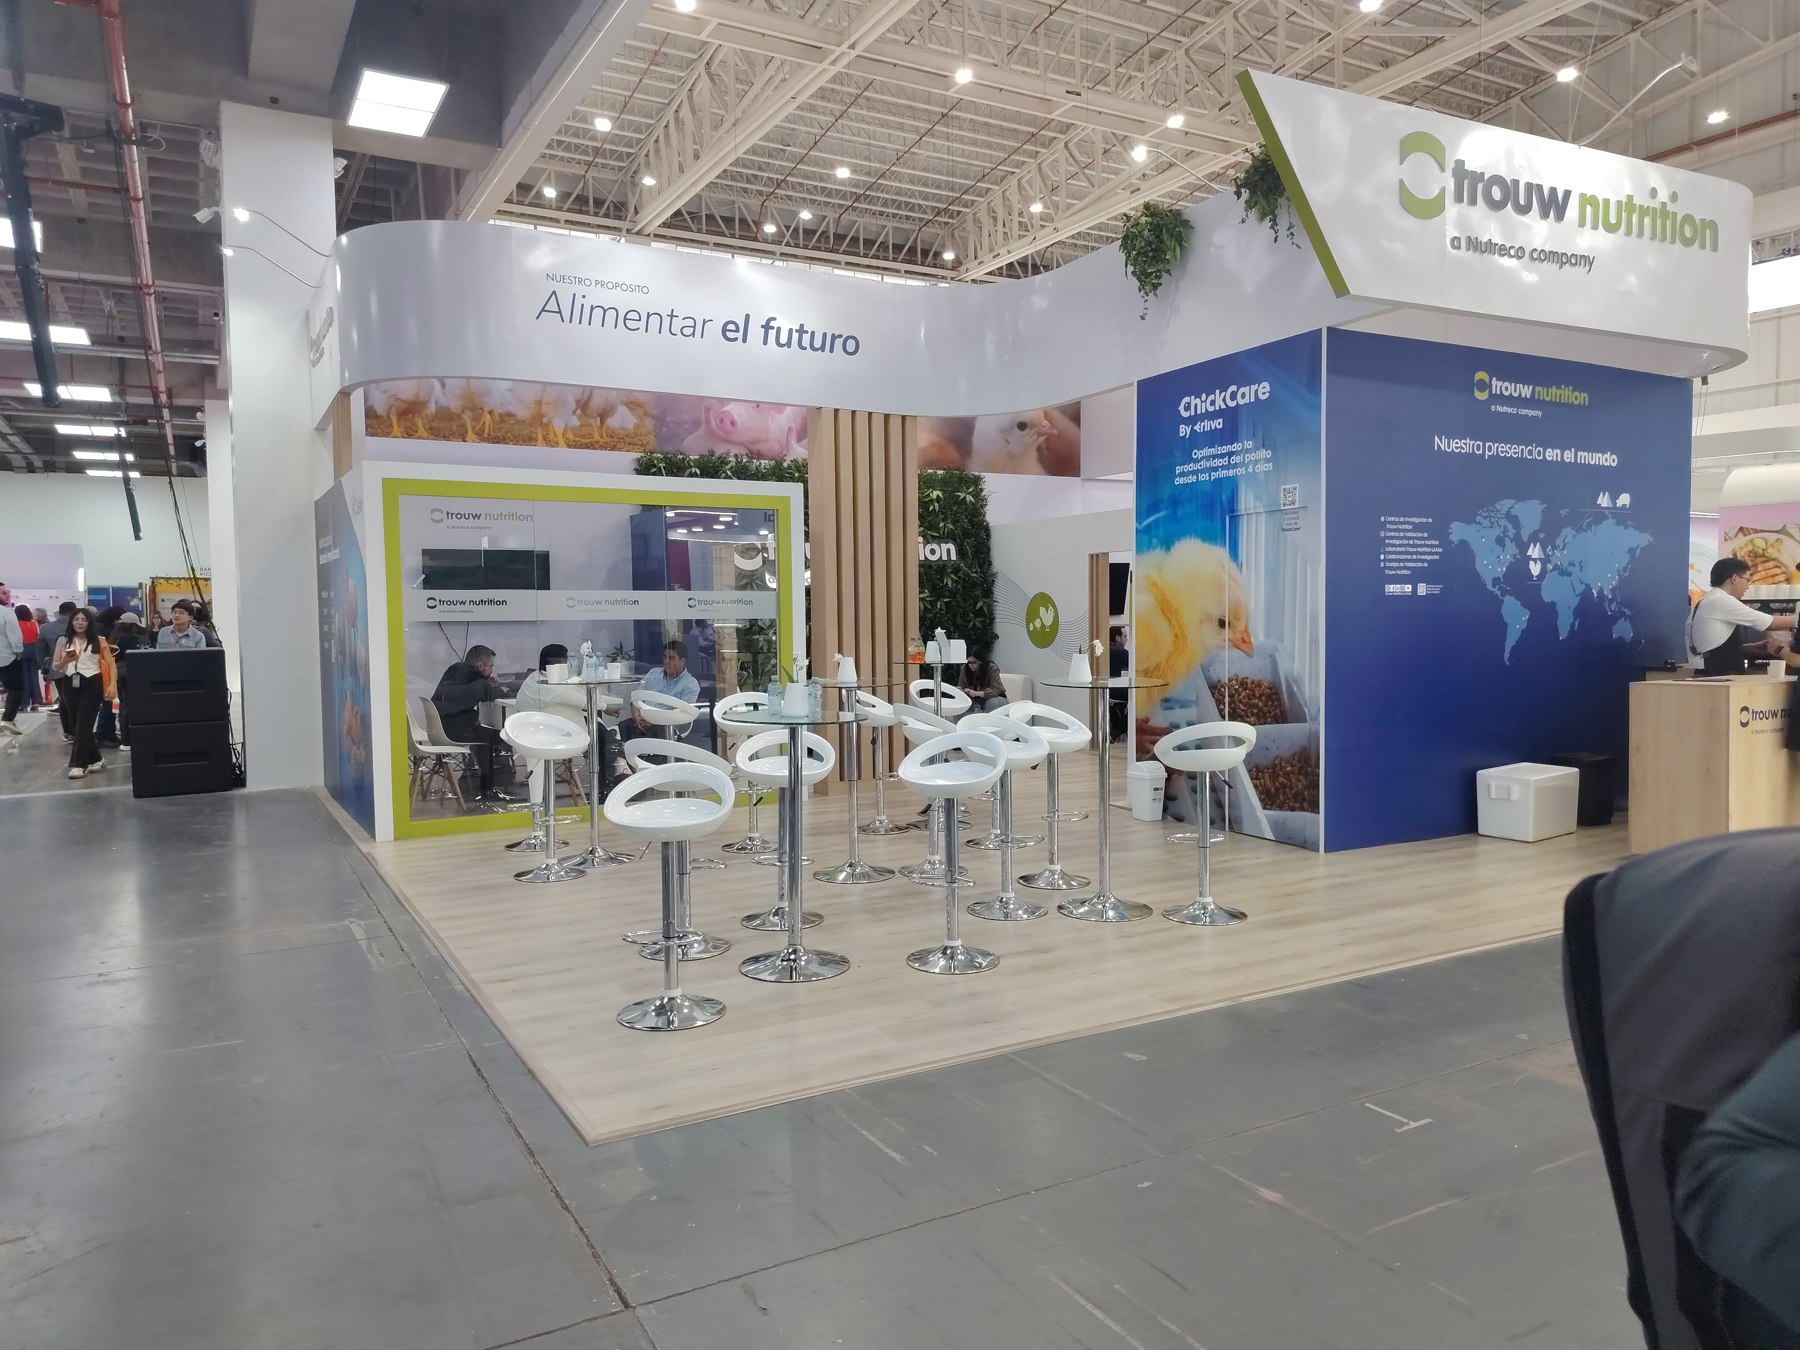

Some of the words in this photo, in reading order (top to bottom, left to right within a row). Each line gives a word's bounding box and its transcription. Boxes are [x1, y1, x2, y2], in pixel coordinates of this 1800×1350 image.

[1452, 159, 1572, 223] trouw
[1578, 187, 1719, 252] nutrition
[1450, 234, 1462, 250] a
[1465, 235, 1526, 261] Nutreco
[1529, 247, 1596, 274] company
[546, 272, 593, 288] NUESTRO
[595, 278, 650, 296] PROPÓSITO
[535, 289, 714, 340] Alimentar
[721, 313, 751, 344] el
[760, 316, 861, 357] futuro
[1178, 381, 1271, 418] ChickCare
[1491, 376, 1533, 399] trouw
[1535, 384, 1590, 406] nutrition
[1496, 404, 1518, 414] Nutreco
[1518, 408, 1543, 419] company
[1179, 424, 1192, 438] By
[1175, 456, 1229, 475] productividad
[1230, 454, 1243, 464] del
[1245, 449, 1272, 463] pollito
[1191, 442, 1243, 460] Optimizando
[1244, 440, 1253, 449] la
[1434, 434, 1483, 454] Nuestra
[1485, 441, 1544, 460] presencia
[1545, 447, 1561, 461] en
[1563, 447, 1575, 463] el
[1577, 449, 1618, 467] mundo
[1174, 475, 1197, 485] desde
[1198, 472, 1209, 482] los
[1210, 467, 1246, 481] primeros
[1247, 465, 1253, 474] 4
[1254, 460, 1273, 472] días
[446, 510, 482, 520] trouw
[484, 511, 533, 522] nutrition
[438, 598, 467, 606] trouw
[468, 597, 508, 606] nutrition
[577, 598, 603, 606] trouw
[604, 597, 640, 606] nutrition
[1751, 708, 1779, 721] trouw
